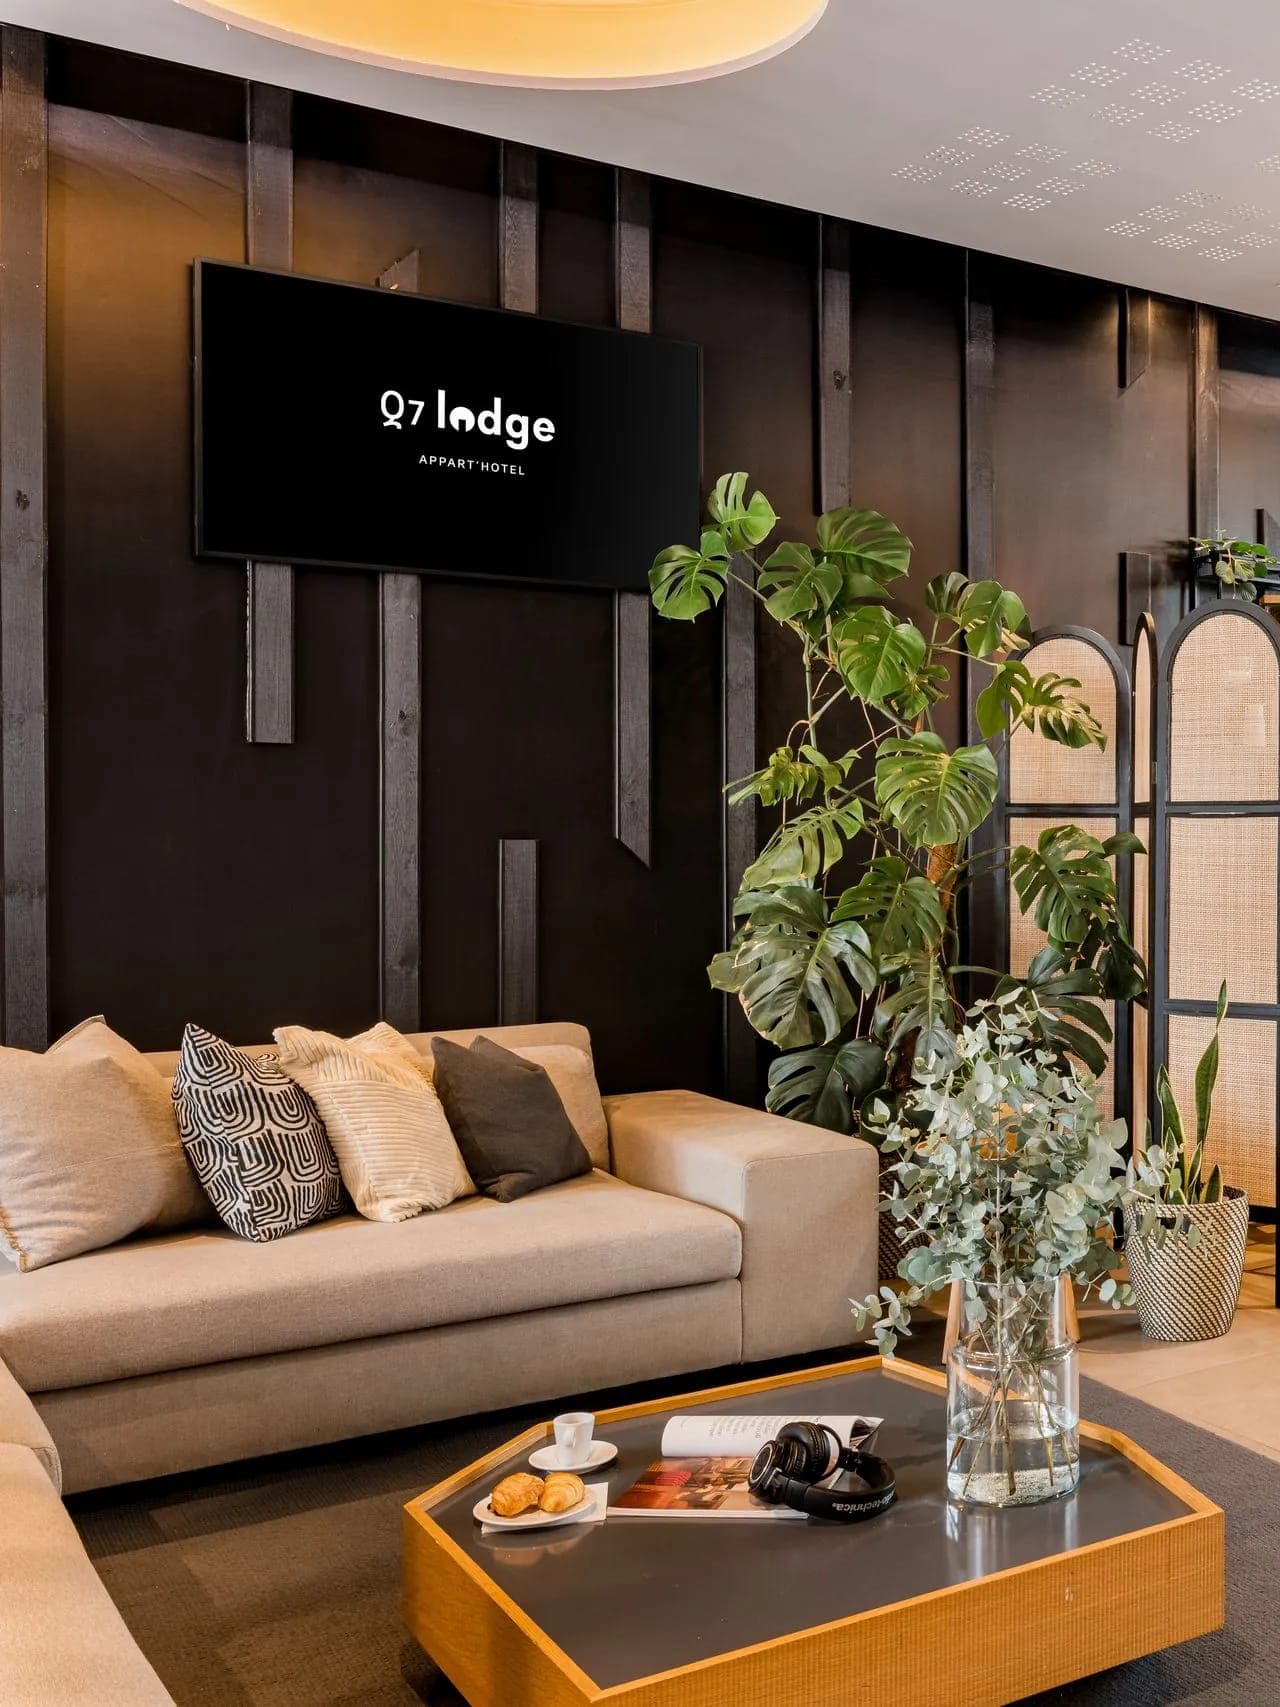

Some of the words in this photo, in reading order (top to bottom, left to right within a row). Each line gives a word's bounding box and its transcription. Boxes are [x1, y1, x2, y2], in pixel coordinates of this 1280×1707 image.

[380, 389, 425, 430] Q7
[437, 388, 556, 451] lodge
[418, 454, 526, 476] APPART'HOTEL
